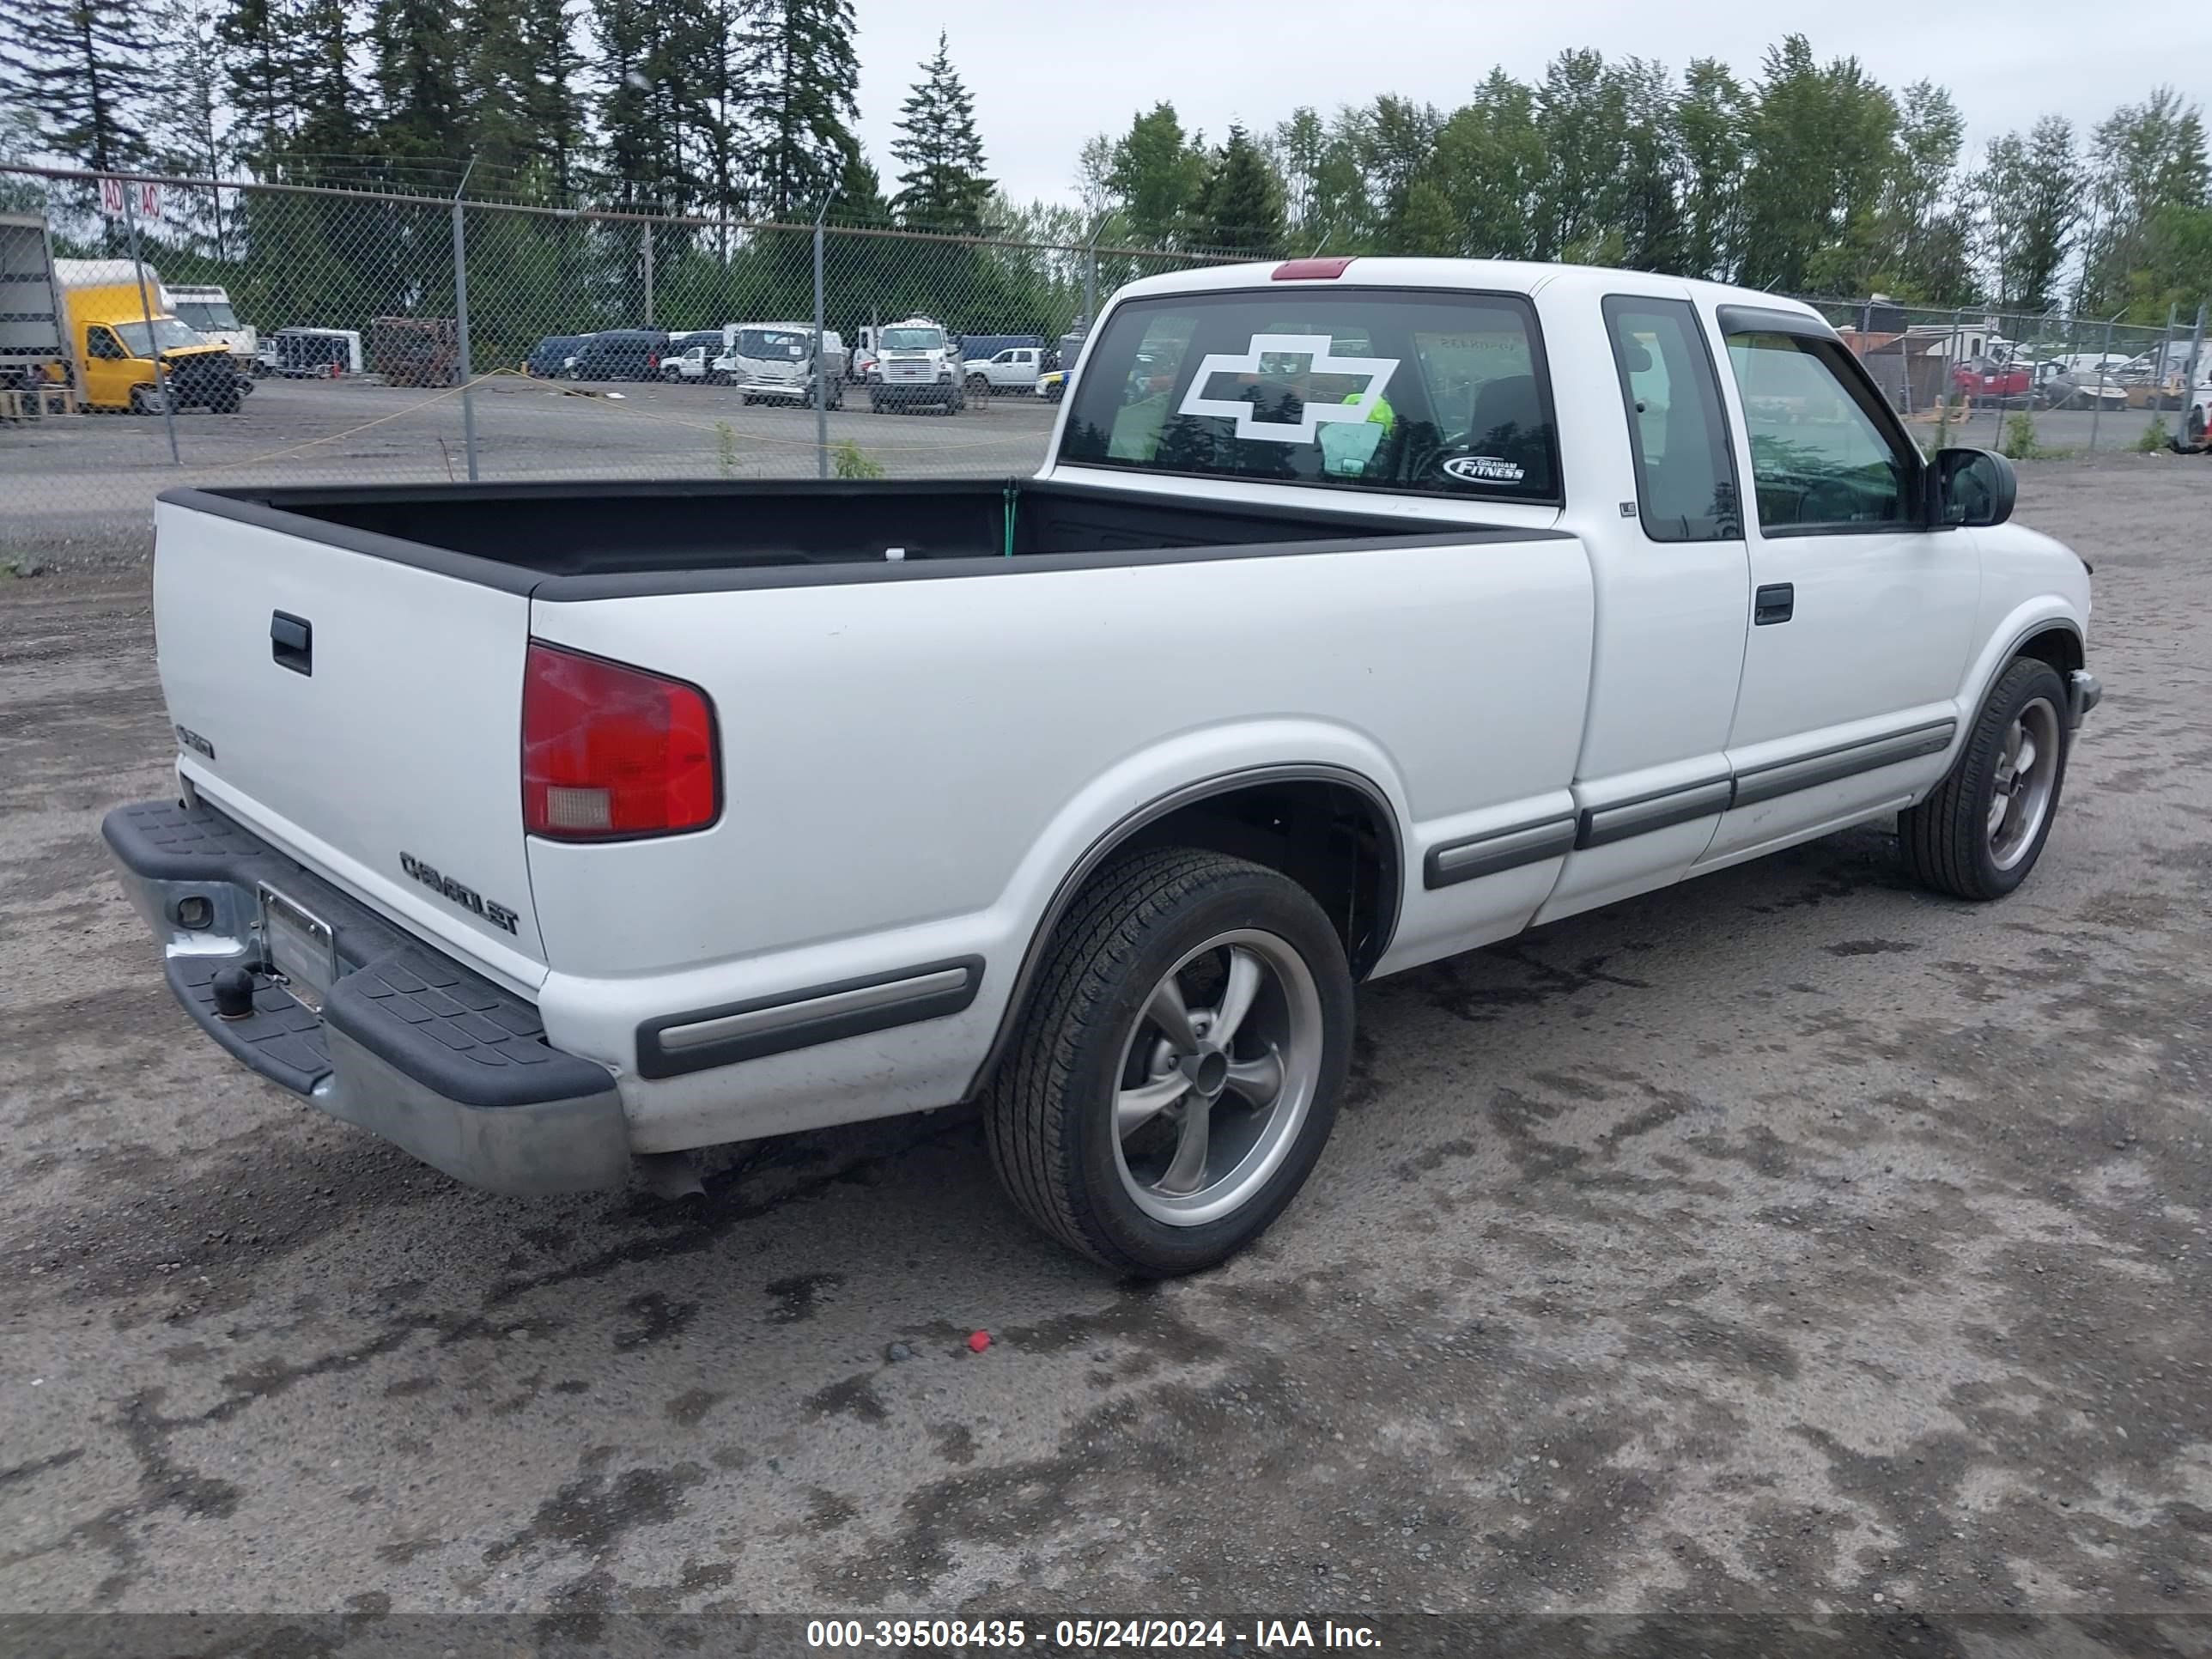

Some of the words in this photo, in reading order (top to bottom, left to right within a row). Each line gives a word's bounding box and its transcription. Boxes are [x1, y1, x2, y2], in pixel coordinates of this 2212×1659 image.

[141, 185, 161, 217] AC
[1455, 460, 1526, 480] FITNESS
[1476, 459, 1518, 469] GRAHAM
[399, 851, 520, 936] CHEVROLET
